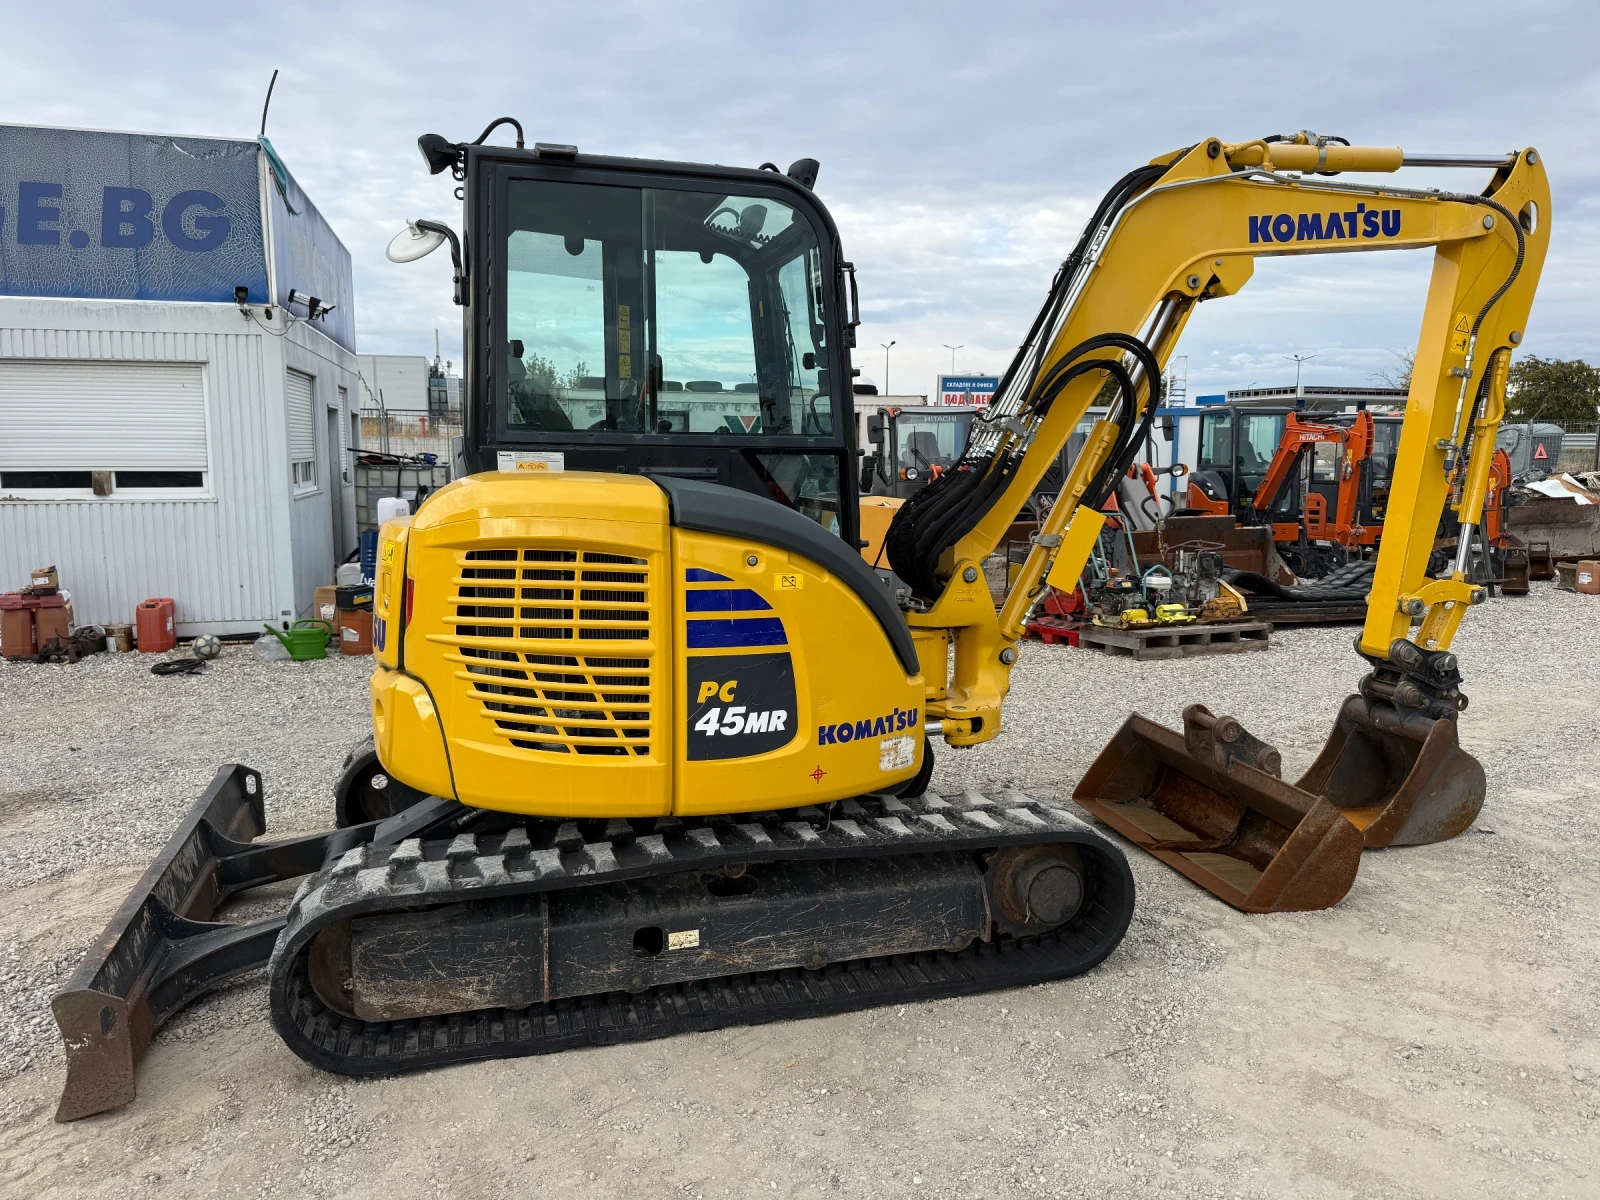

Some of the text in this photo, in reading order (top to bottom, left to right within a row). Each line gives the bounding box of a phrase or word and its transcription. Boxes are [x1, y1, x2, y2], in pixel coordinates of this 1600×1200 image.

[0, 181, 232, 251] E.BG
[1249, 203, 1401, 244] KOMATSU
[924, 415, 957, 423] HITACHI
[1299, 433, 1325, 441] HITACHI
[697, 680, 738, 704] PC
[694, 706, 788, 736] 45MR
[818, 707, 918, 746] KOMATSU
